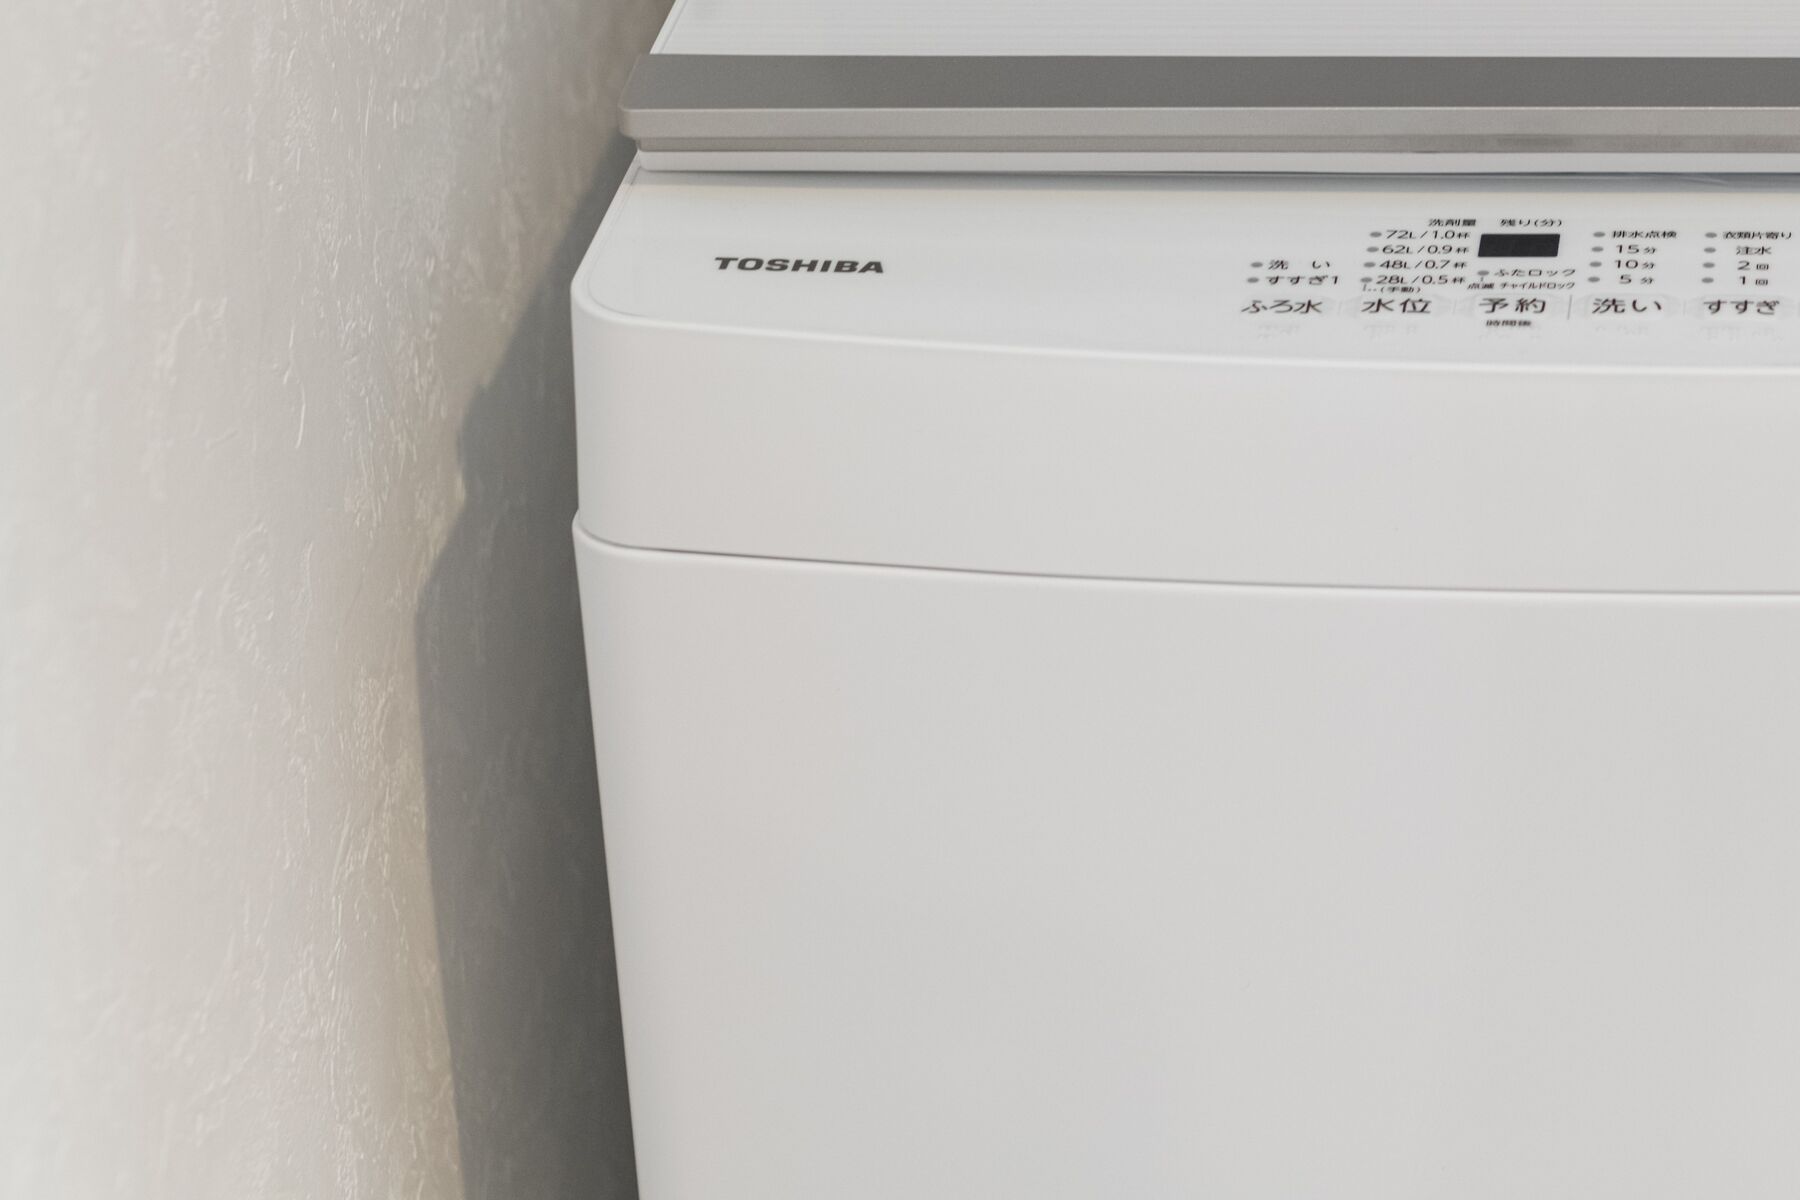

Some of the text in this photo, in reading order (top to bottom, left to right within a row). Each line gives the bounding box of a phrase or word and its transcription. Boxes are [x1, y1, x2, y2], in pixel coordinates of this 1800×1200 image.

[1612, 230, 1677, 239] 排水点検
[1736, 246, 1773, 256] 注水
[714, 257, 885, 274] TOSHIBA
[1494, 268, 1576, 277] ふたロック
[1500, 282, 1575, 290] チャイルドロック
[1241, 300, 1323, 314] ふろ水
[1361, 299, 1432, 314] 水位
[1478, 298, 1546, 314] 予約
[1592, 298, 1663, 314] 洗い
[1703, 300, 1780, 315] すすぎ
